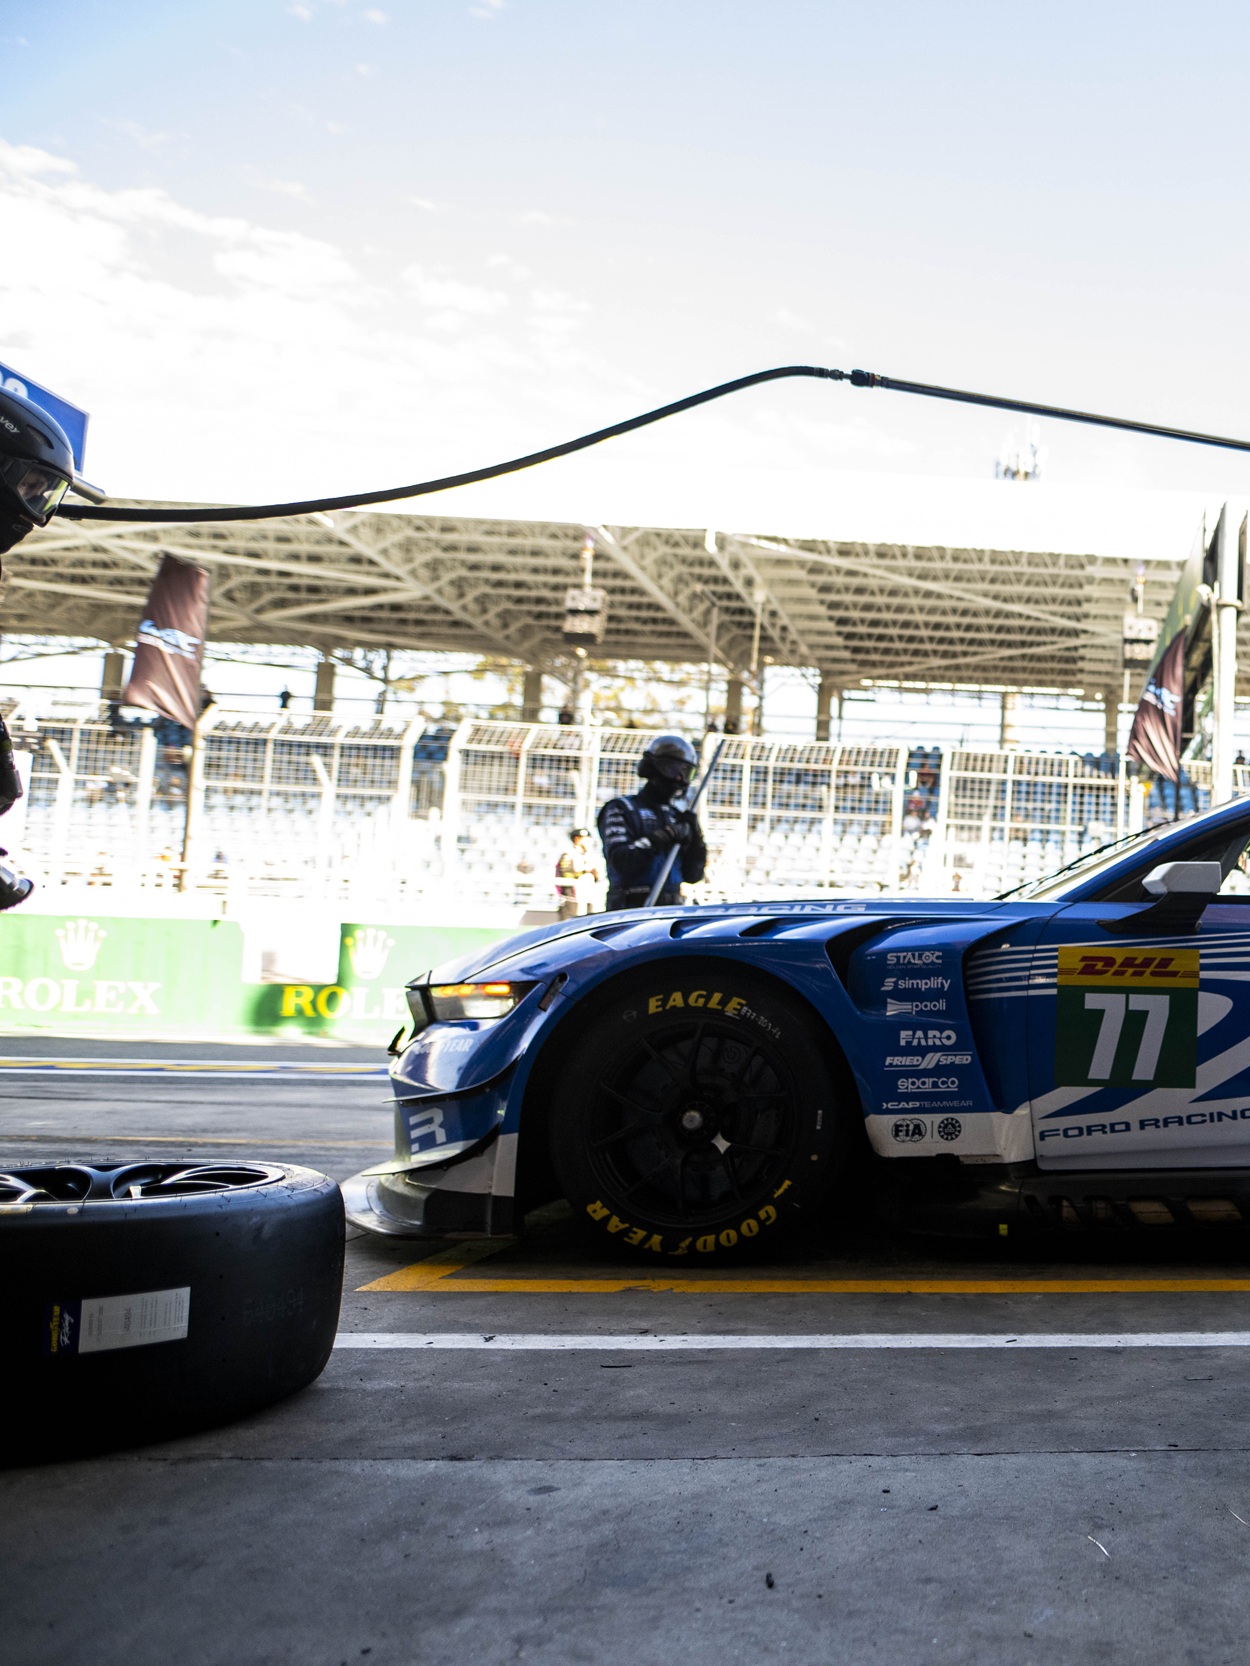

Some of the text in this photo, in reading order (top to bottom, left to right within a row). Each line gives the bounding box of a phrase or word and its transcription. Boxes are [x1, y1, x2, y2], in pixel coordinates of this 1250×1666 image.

[696, 904, 867, 915] RACING
[1077, 955, 1182, 978] DHL
[897, 977, 951, 991] simplify
[0, 977, 162, 1014] ROLEX
[281, 985, 409, 1020] ROLE
[647, 990, 747, 1016] EAGLE
[912, 999, 946, 1015] paoli
[899, 1030, 957, 1046] FARO
[1084, 993, 1170, 1081] 77
[885, 1055, 972, 1066] FRIED SPED
[897, 1077, 959, 1092] sparco
[1038, 1118, 1131, 1142] FORD
